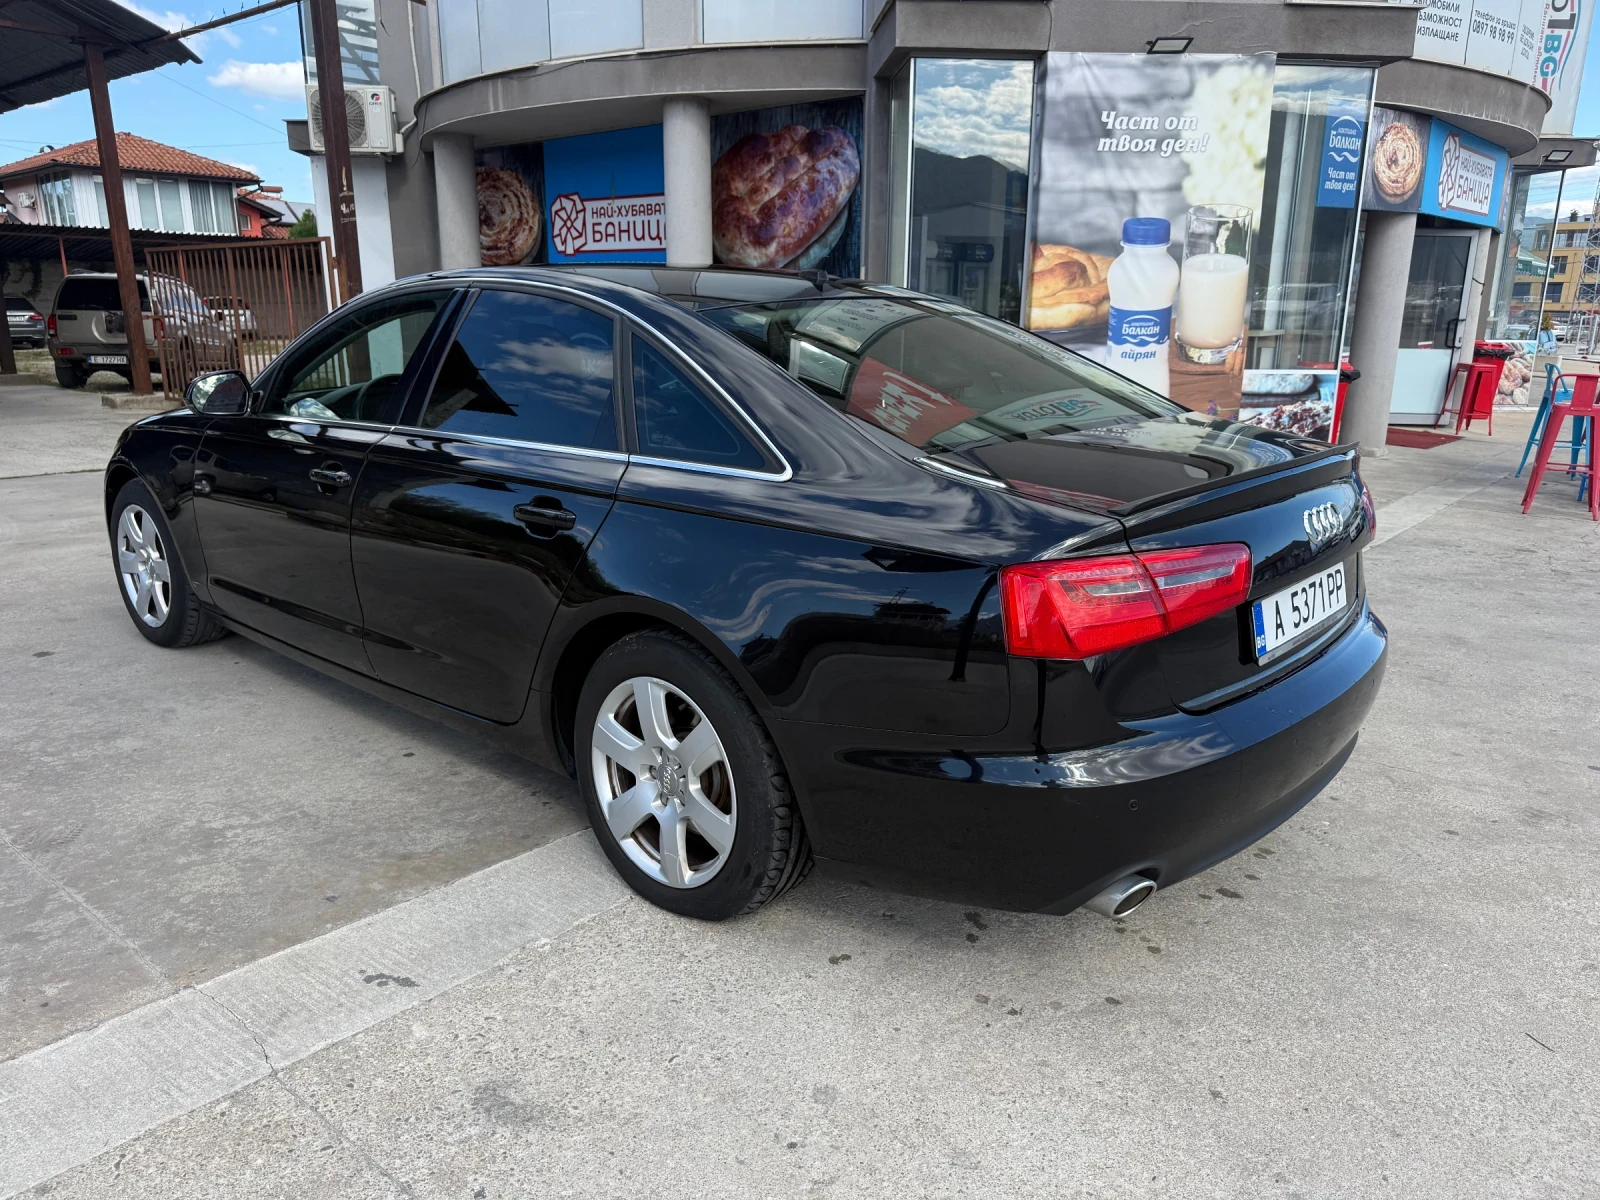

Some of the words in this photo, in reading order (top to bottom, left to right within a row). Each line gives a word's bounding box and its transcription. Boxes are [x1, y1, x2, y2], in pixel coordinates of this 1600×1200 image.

[1416, 25, 1459, 42] ИЗПЛАЩАНЕ
[1472, 19, 1488, 36] 0897
[1489, 24, 1498, 39] 98
[1498, 28, 1506, 42] 98
[1506, 31, 1514, 44] 99
[1101, 110, 1160, 130] Част
[1164, 116, 1198, 130] от
[1097, 134, 1157, 152] твоя
[1160, 133, 1210, 158] ден!
[1329, 130, 1361, 151] Балкан
[1328, 166, 1345, 179] Част
[1345, 171, 1355, 180] от
[1324, 179, 1341, 190] твоя
[1342, 180, 1356, 193] ден!
[1456, 174, 1490, 210] БАНИЦА
[1121, 323, 1160, 335] Балкан
[1120, 349, 1157, 363] айрян
[1275, 600, 1285, 640] A
[1256, 634, 1266, 648] BG
